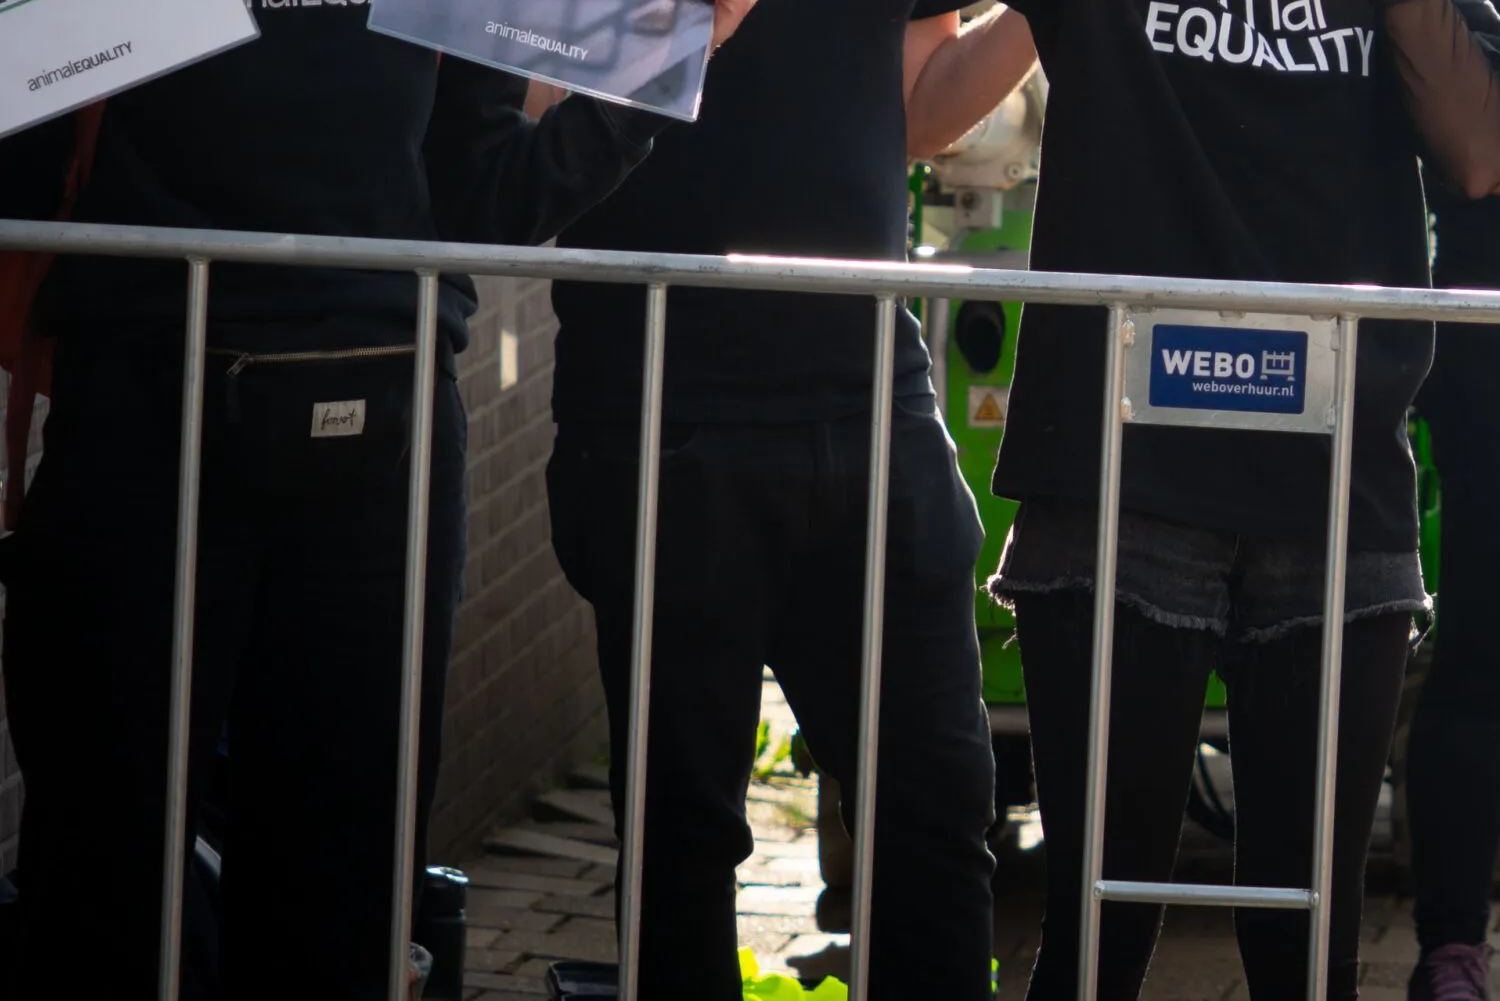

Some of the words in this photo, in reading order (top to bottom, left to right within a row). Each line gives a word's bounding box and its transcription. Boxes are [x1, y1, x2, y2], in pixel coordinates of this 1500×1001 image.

[485, 21, 588, 61] animalEQUALITY
[1145, 1, 1374, 77] EQUALITY
[27, 40, 132, 92] animalEQUALITY
[1162, 348, 1255, 379] WEBO
[1192, 381, 1294, 397] weboverhuur.nl
